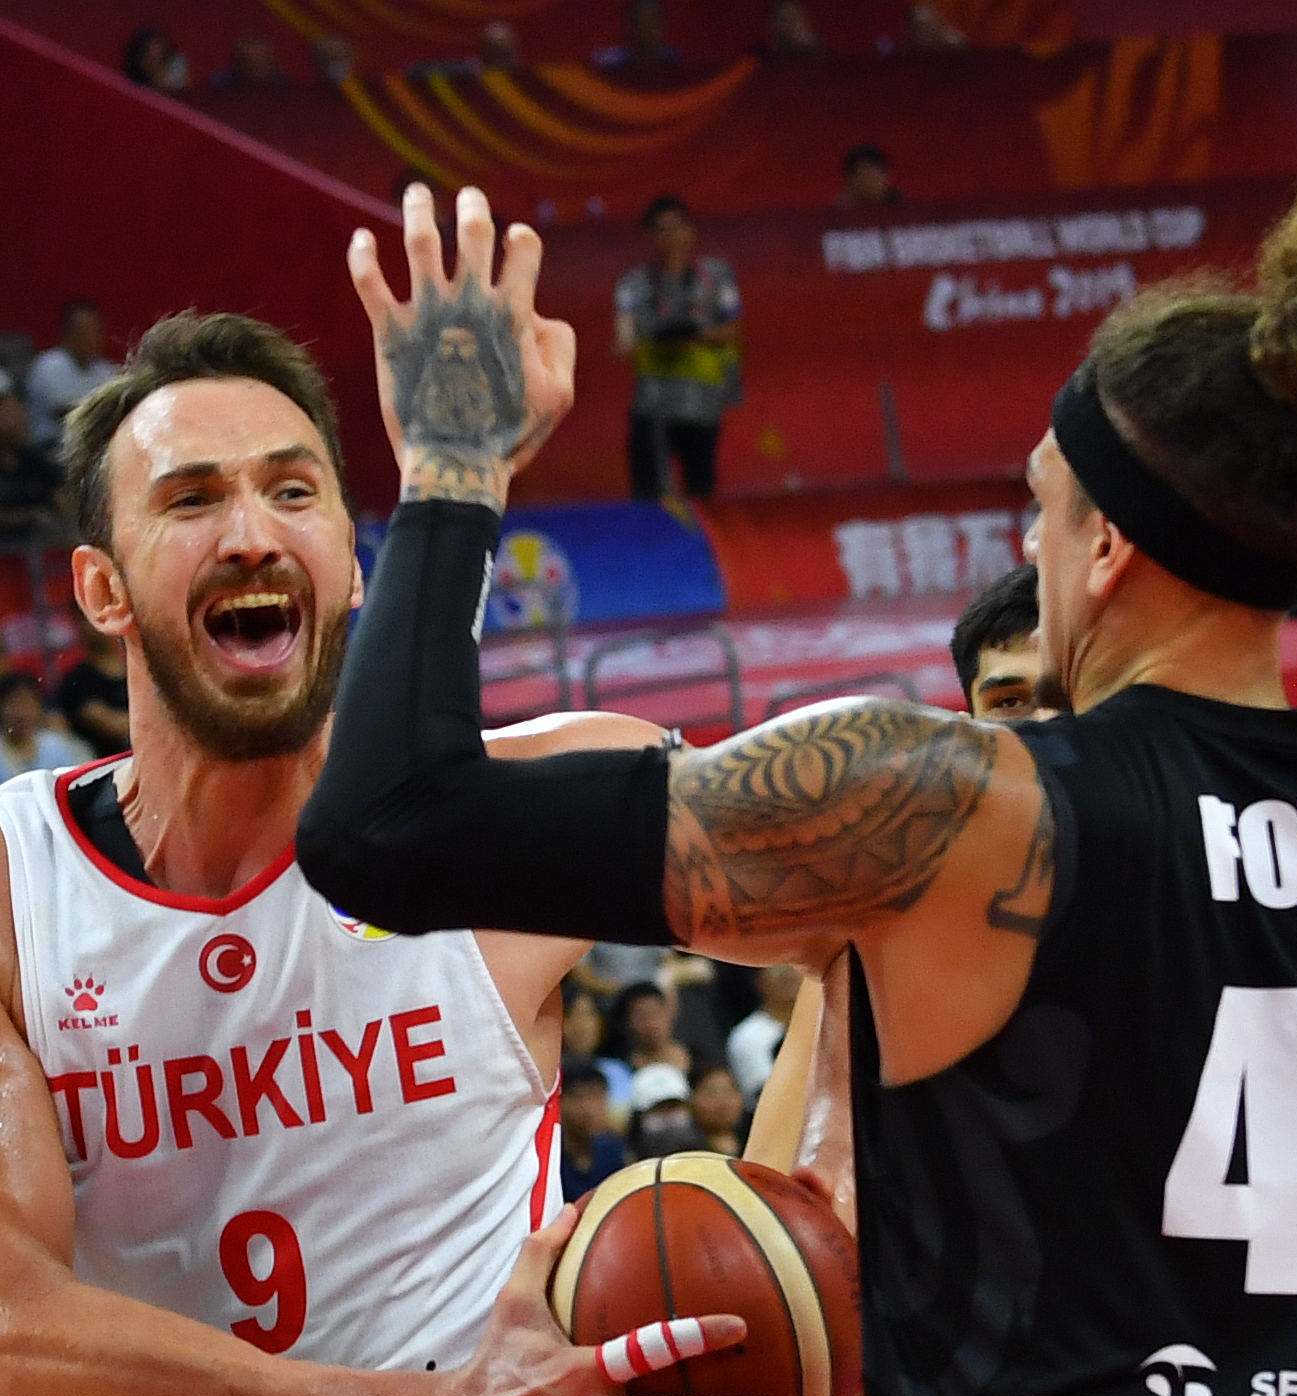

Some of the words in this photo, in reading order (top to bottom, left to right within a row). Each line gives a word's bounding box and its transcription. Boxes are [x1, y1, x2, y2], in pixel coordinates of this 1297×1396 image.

[48, 1004, 457, 1162] TÜRKİYE
[58, 1014, 120, 1032] KELME
[218, 1209, 308, 1356] 9
